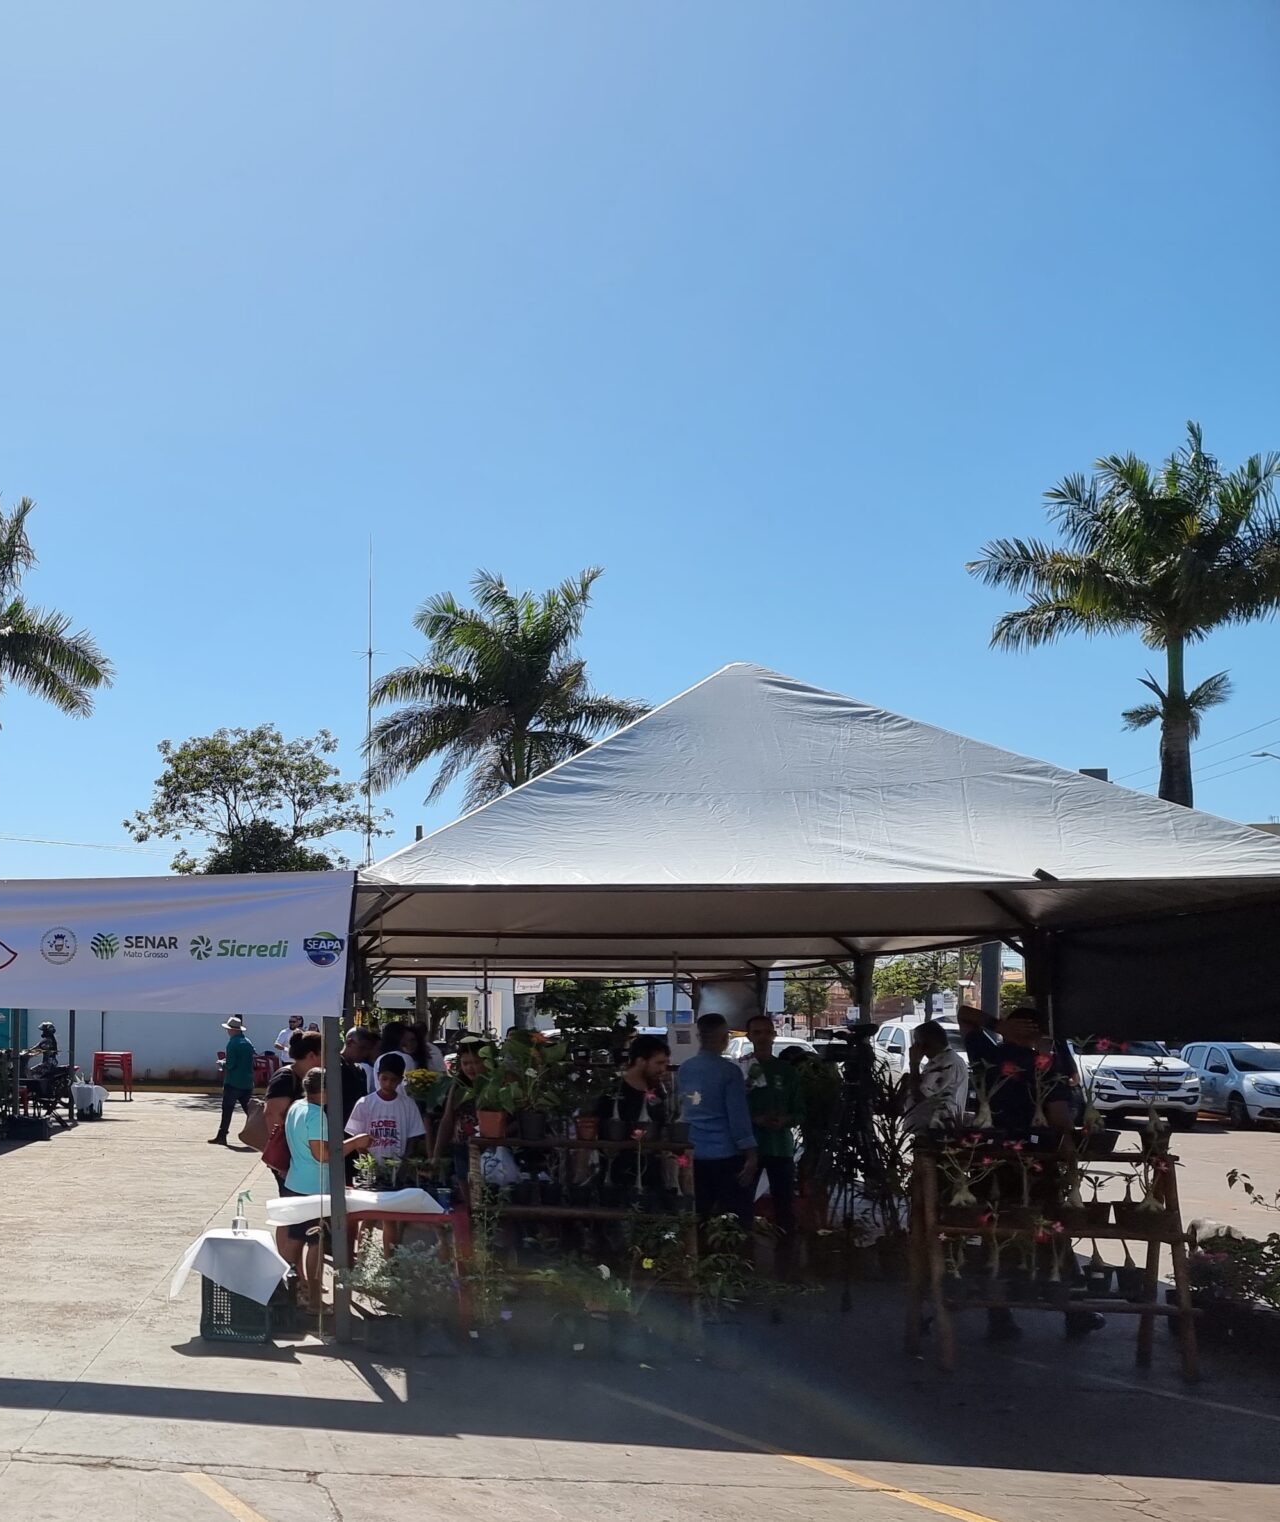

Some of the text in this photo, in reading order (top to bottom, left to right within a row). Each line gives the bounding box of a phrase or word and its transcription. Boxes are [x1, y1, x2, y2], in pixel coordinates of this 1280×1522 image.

[123, 935, 178, 949] SENAR
[306, 940, 342, 950] SEAPA
[123, 950, 169, 959] Mato Grosso
[216, 939, 289, 958] Sicredi
